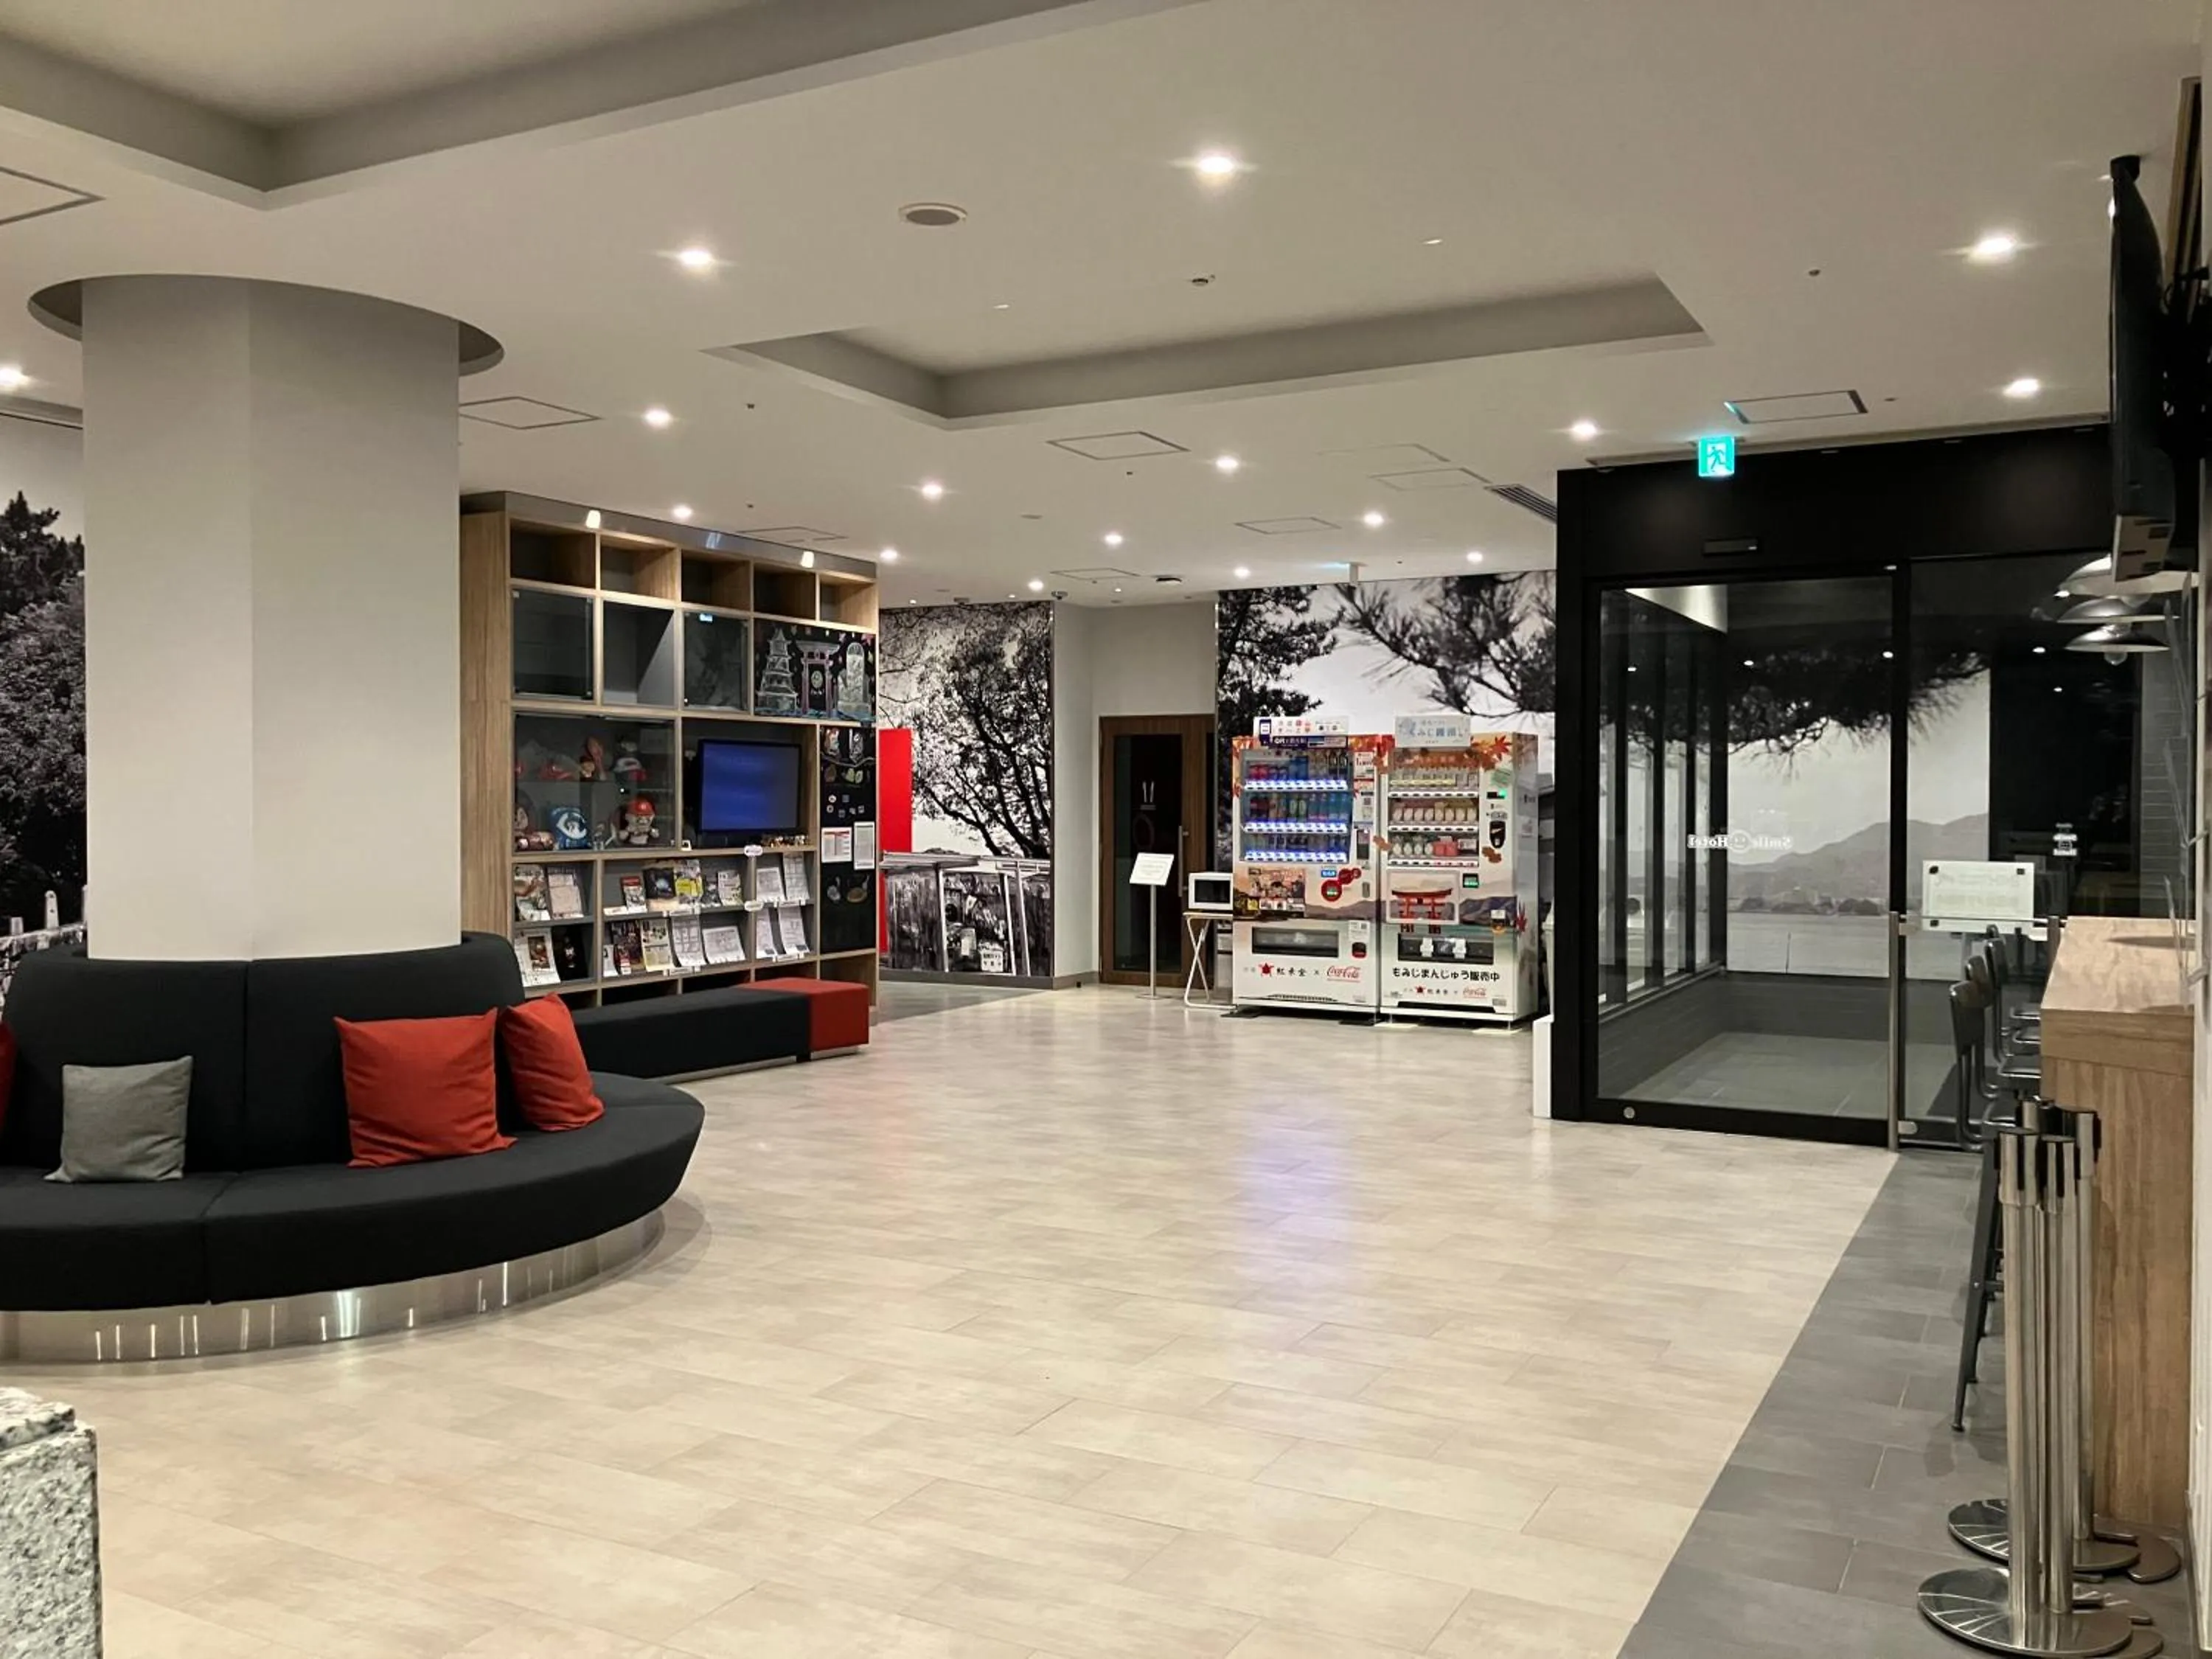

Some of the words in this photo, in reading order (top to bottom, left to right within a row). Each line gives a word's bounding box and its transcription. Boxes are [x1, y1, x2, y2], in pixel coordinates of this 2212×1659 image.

[1393, 967, 1500, 981] もみじまんじゅう販売中
